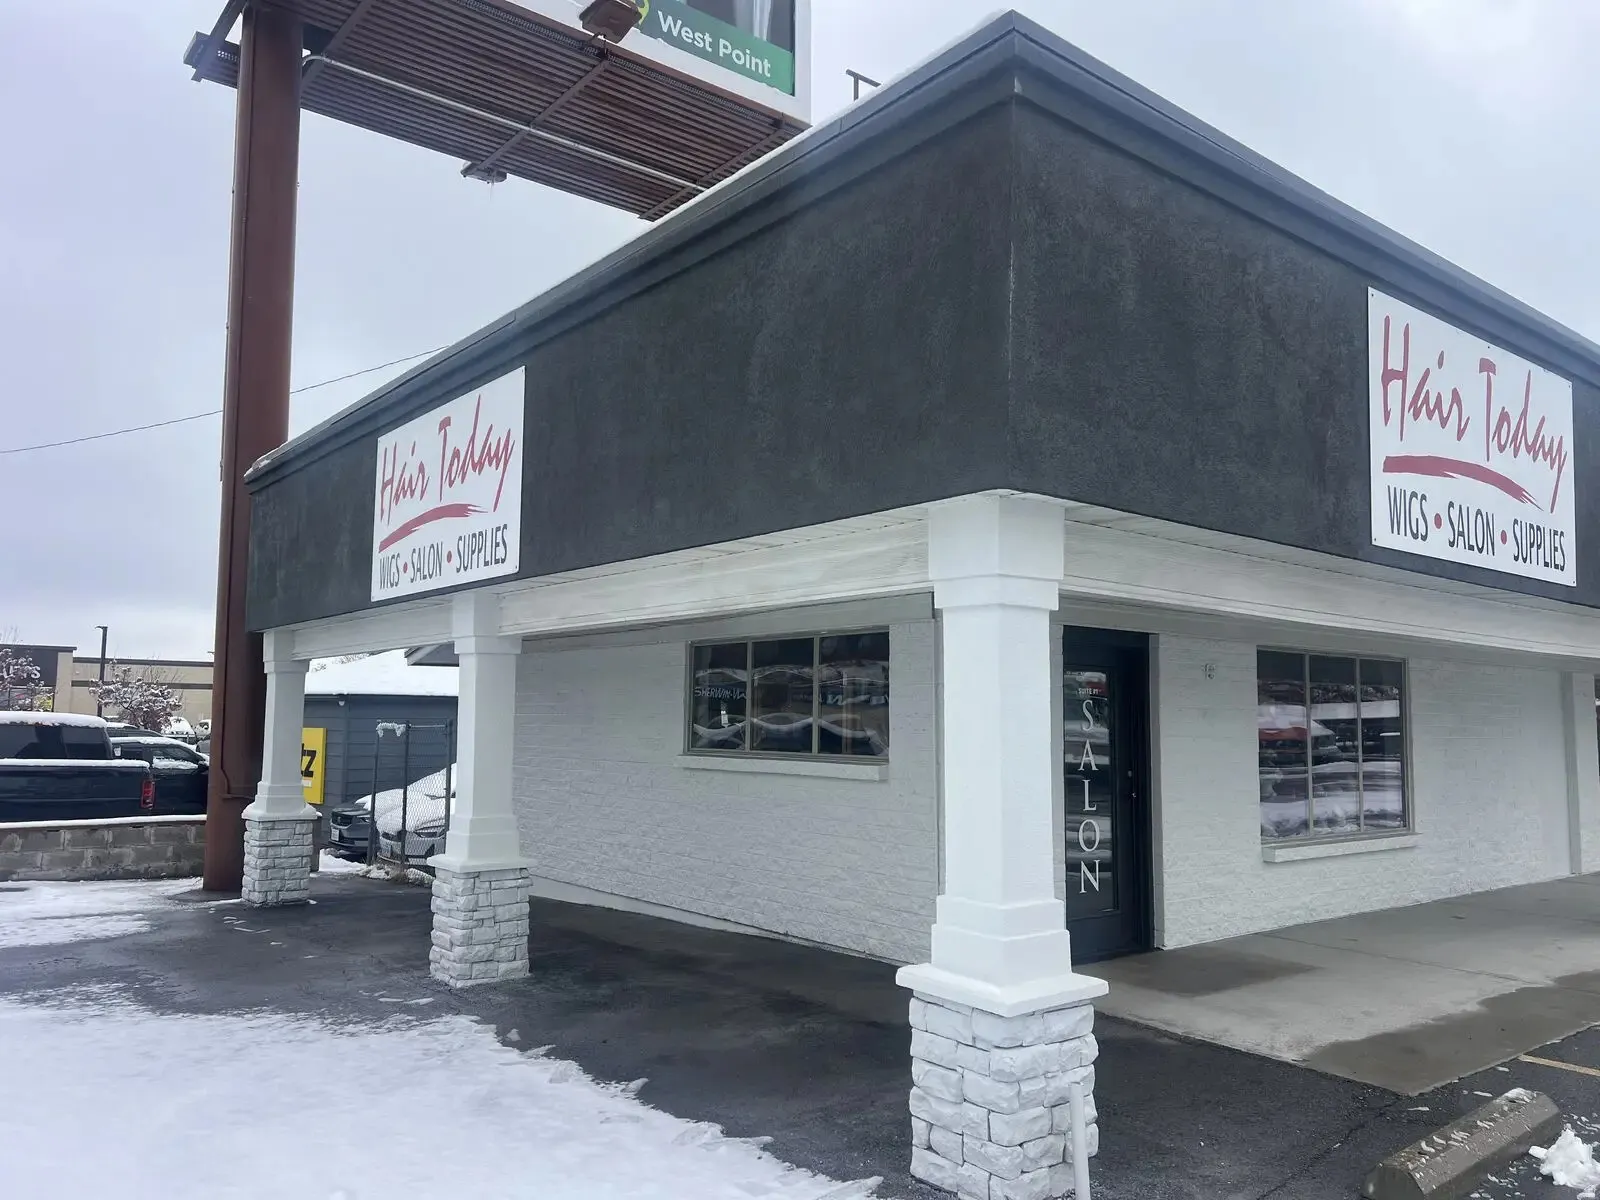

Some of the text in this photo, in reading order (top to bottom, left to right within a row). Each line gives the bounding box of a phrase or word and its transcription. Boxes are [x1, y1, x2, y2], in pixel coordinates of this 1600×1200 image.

[657, 10, 771, 78] West Point
[380, 394, 516, 526] Hair Today
[1381, 315, 1567, 514] Hair Today
[379, 523, 508, 589] WIGS SALON SUPPLIES
[1387, 485, 1566, 572] WIGS SALON SUPPLIES
[1078, 700, 1100, 894] SALON
